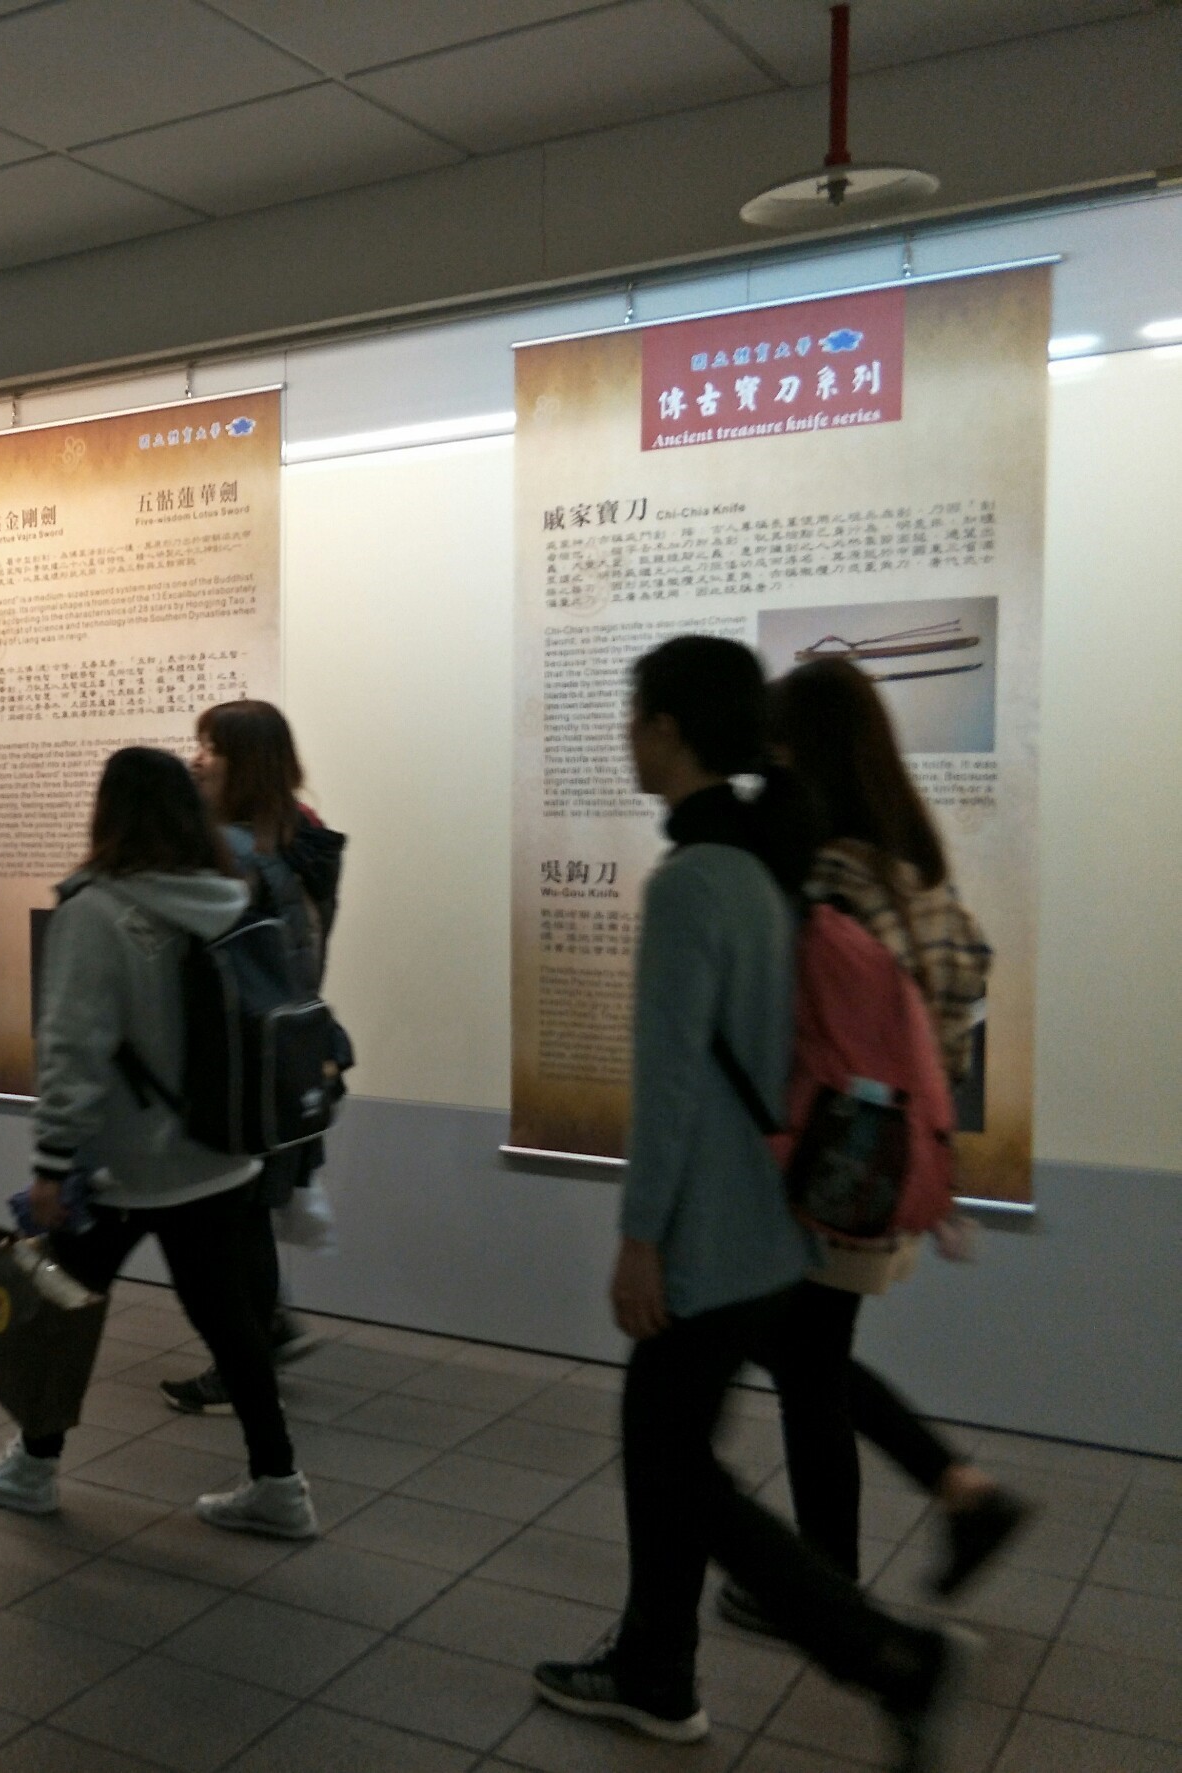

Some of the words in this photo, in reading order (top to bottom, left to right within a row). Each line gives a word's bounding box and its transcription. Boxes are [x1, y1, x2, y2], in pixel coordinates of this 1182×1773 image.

[652, 428, 713, 449] Ancient
[717, 420, 781, 440] treasure
[785, 411, 828, 433] knife
[832, 408, 881, 426] series
[135, 512, 191, 526] Five-wisdom
[193, 510, 218, 520] Lotus
[221, 505, 250, 517] Sword
[656, 506, 710, 521] Chi-Chia
[712, 502, 746, 515] Knife
[17, 531, 37, 542] Vajra
[38, 528, 64, 540] Sword
[116, 584, 144, 595] system
[147, 582, 161, 590] and
[198, 577, 211, 586] the
[91, 598, 110, 606] from
[136, 594, 149, 602] the
[150, 603, 172, 612] stars
[33, 623, 63, 632] science
[81, 618, 125, 629] technology
[135, 616, 147, 624] the
[149, 612, 187, 622] Southern
[540, 887, 585, 898] Wu-Gou
[588, 888, 620, 898] Knife
